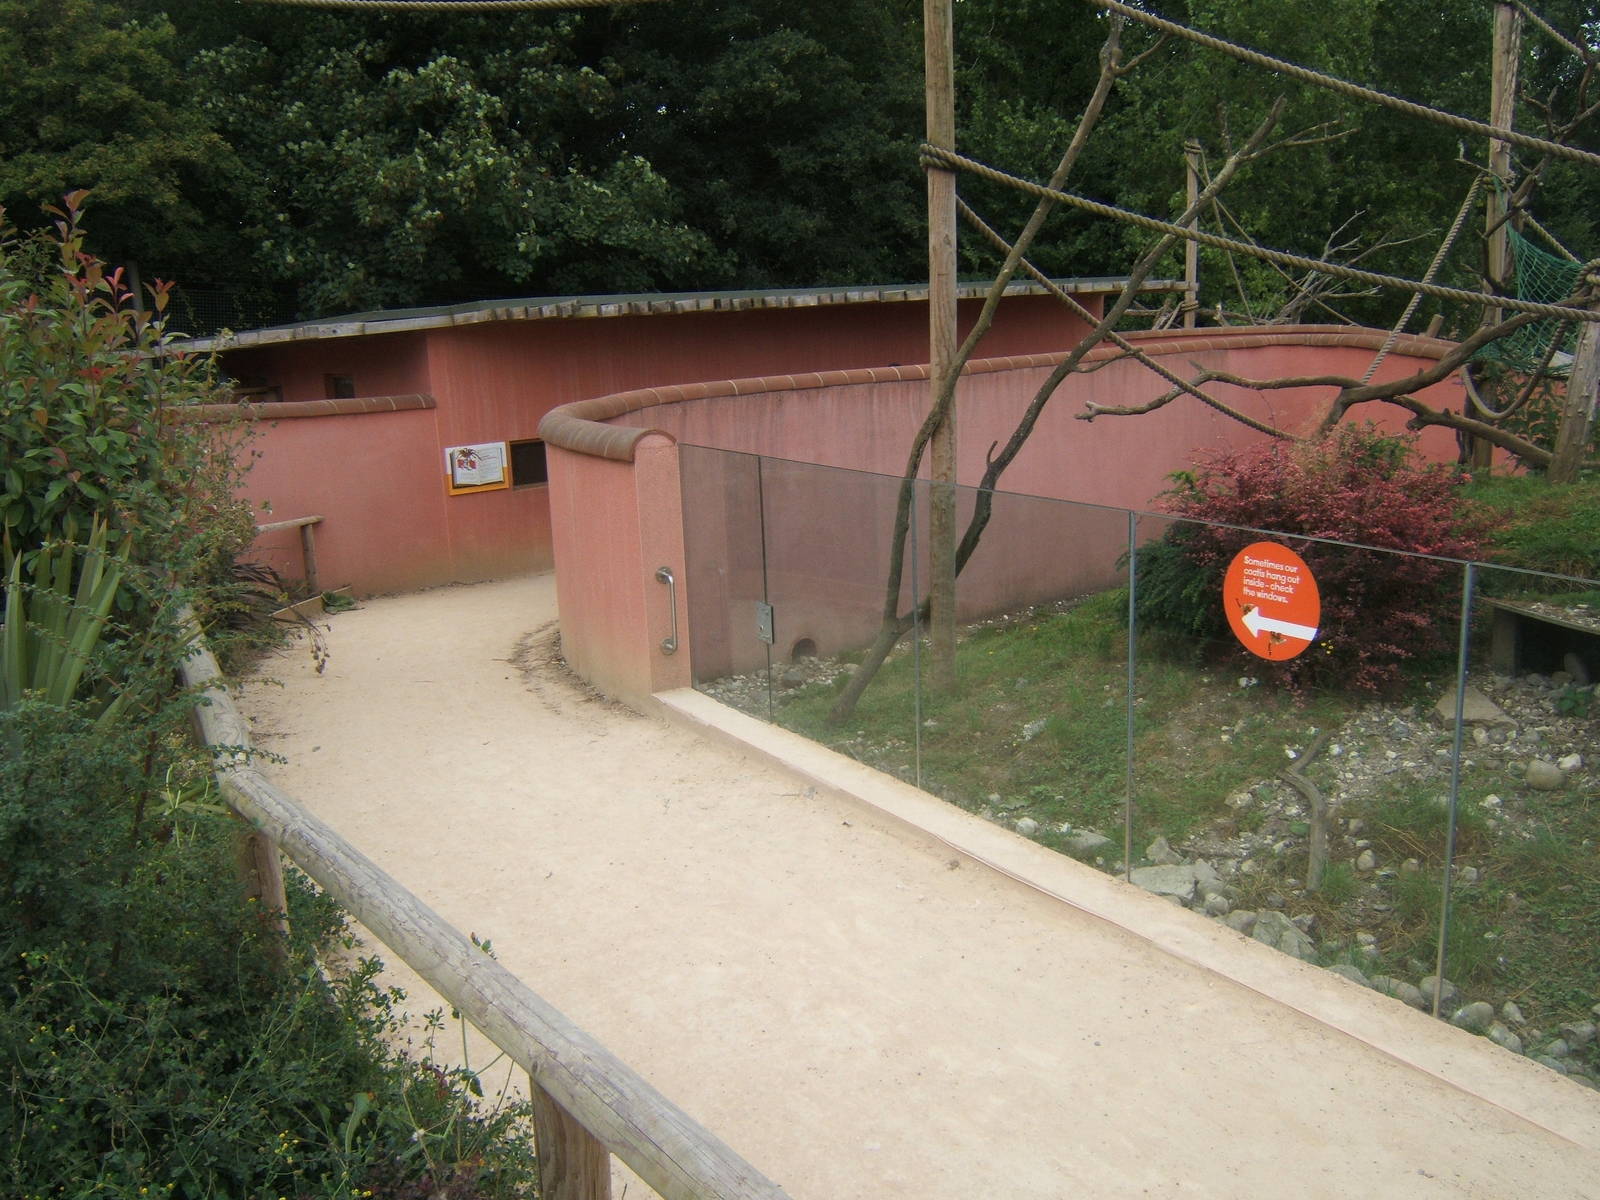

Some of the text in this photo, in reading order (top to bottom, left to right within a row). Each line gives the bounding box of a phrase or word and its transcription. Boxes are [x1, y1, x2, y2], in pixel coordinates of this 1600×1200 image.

[1243, 555, 1298, 573] Sometimes our
[1243, 567, 1300, 584] coatis hang out
[1243, 576, 1264, 588] inside
[1270, 582, 1294, 594] check
[1243, 586, 1288, 603] the windows.
